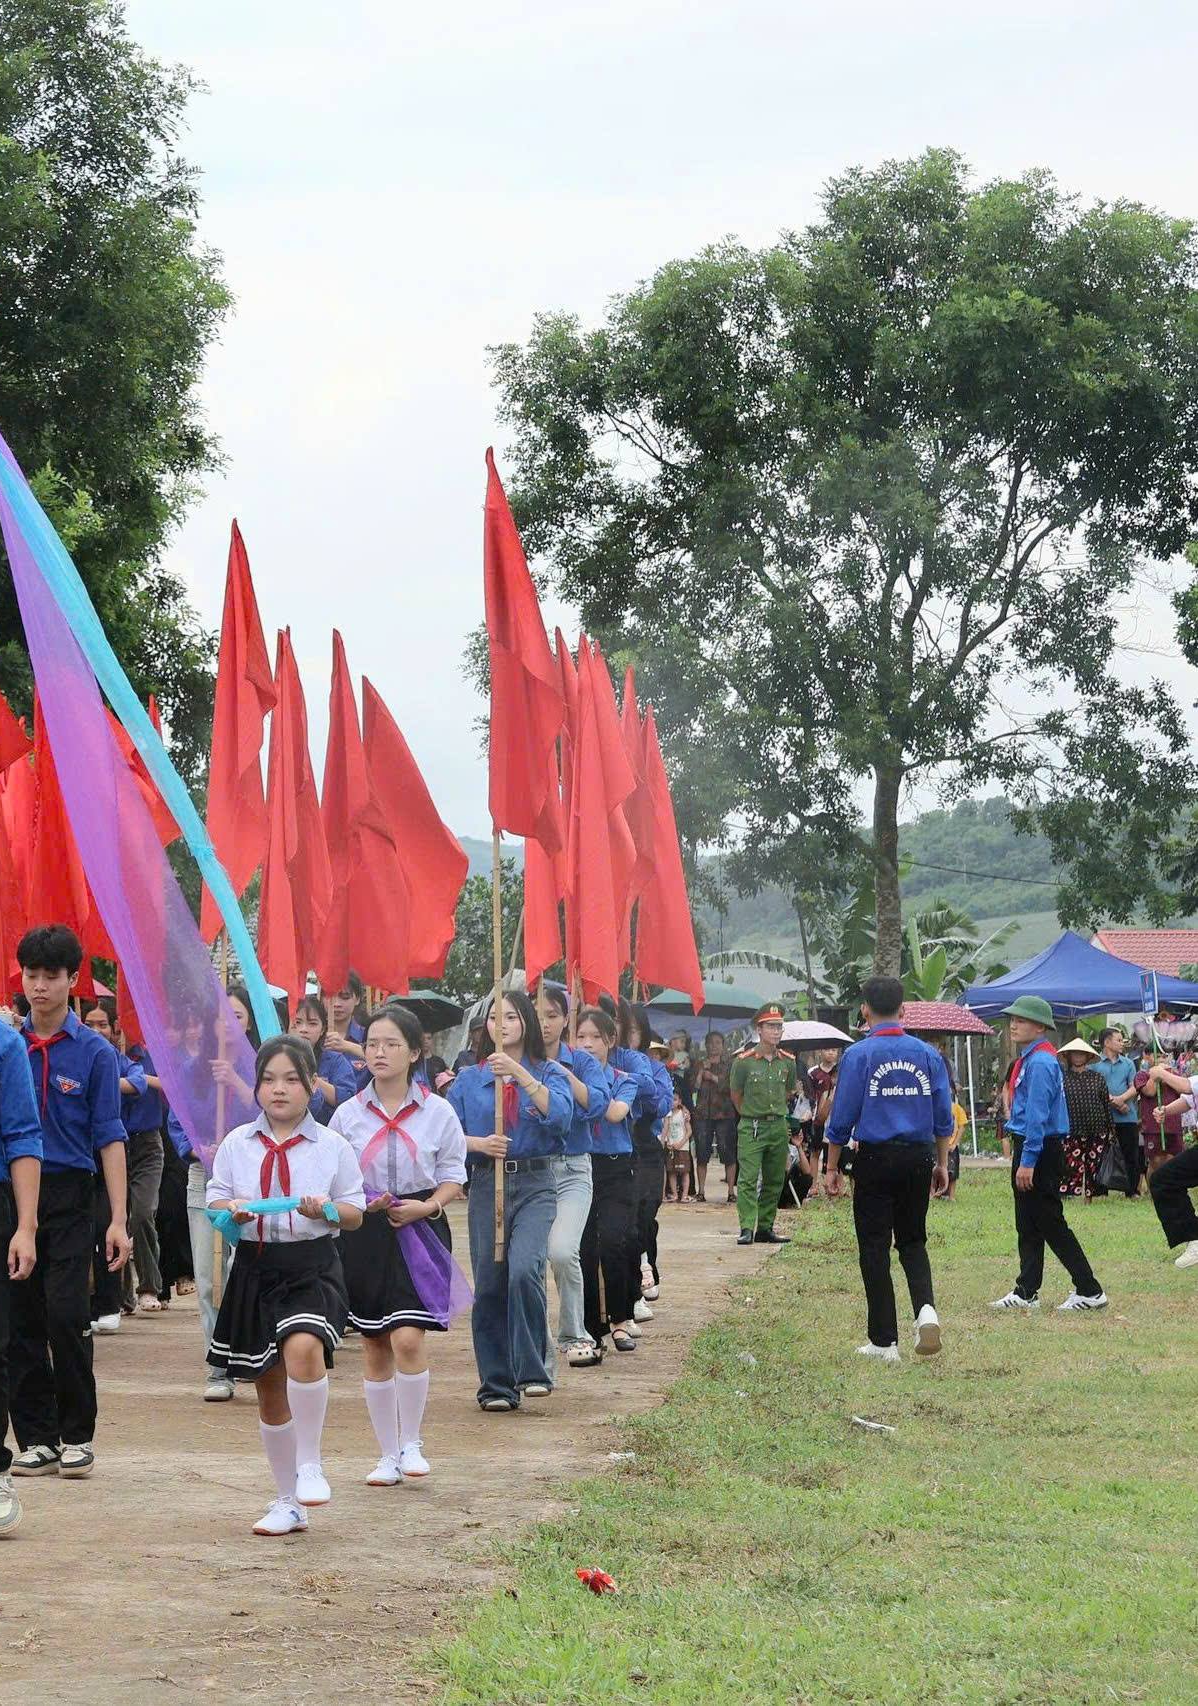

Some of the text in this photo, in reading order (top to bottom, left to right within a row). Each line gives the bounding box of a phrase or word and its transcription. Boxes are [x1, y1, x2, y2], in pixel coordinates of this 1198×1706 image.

[873, 1062, 892, 1079] VIỆN
[891, 1059, 916, 1073] HÀNH
[869, 1079, 879, 1097] HỌC
[881, 1085, 918, 1097] QUỐC GIA
